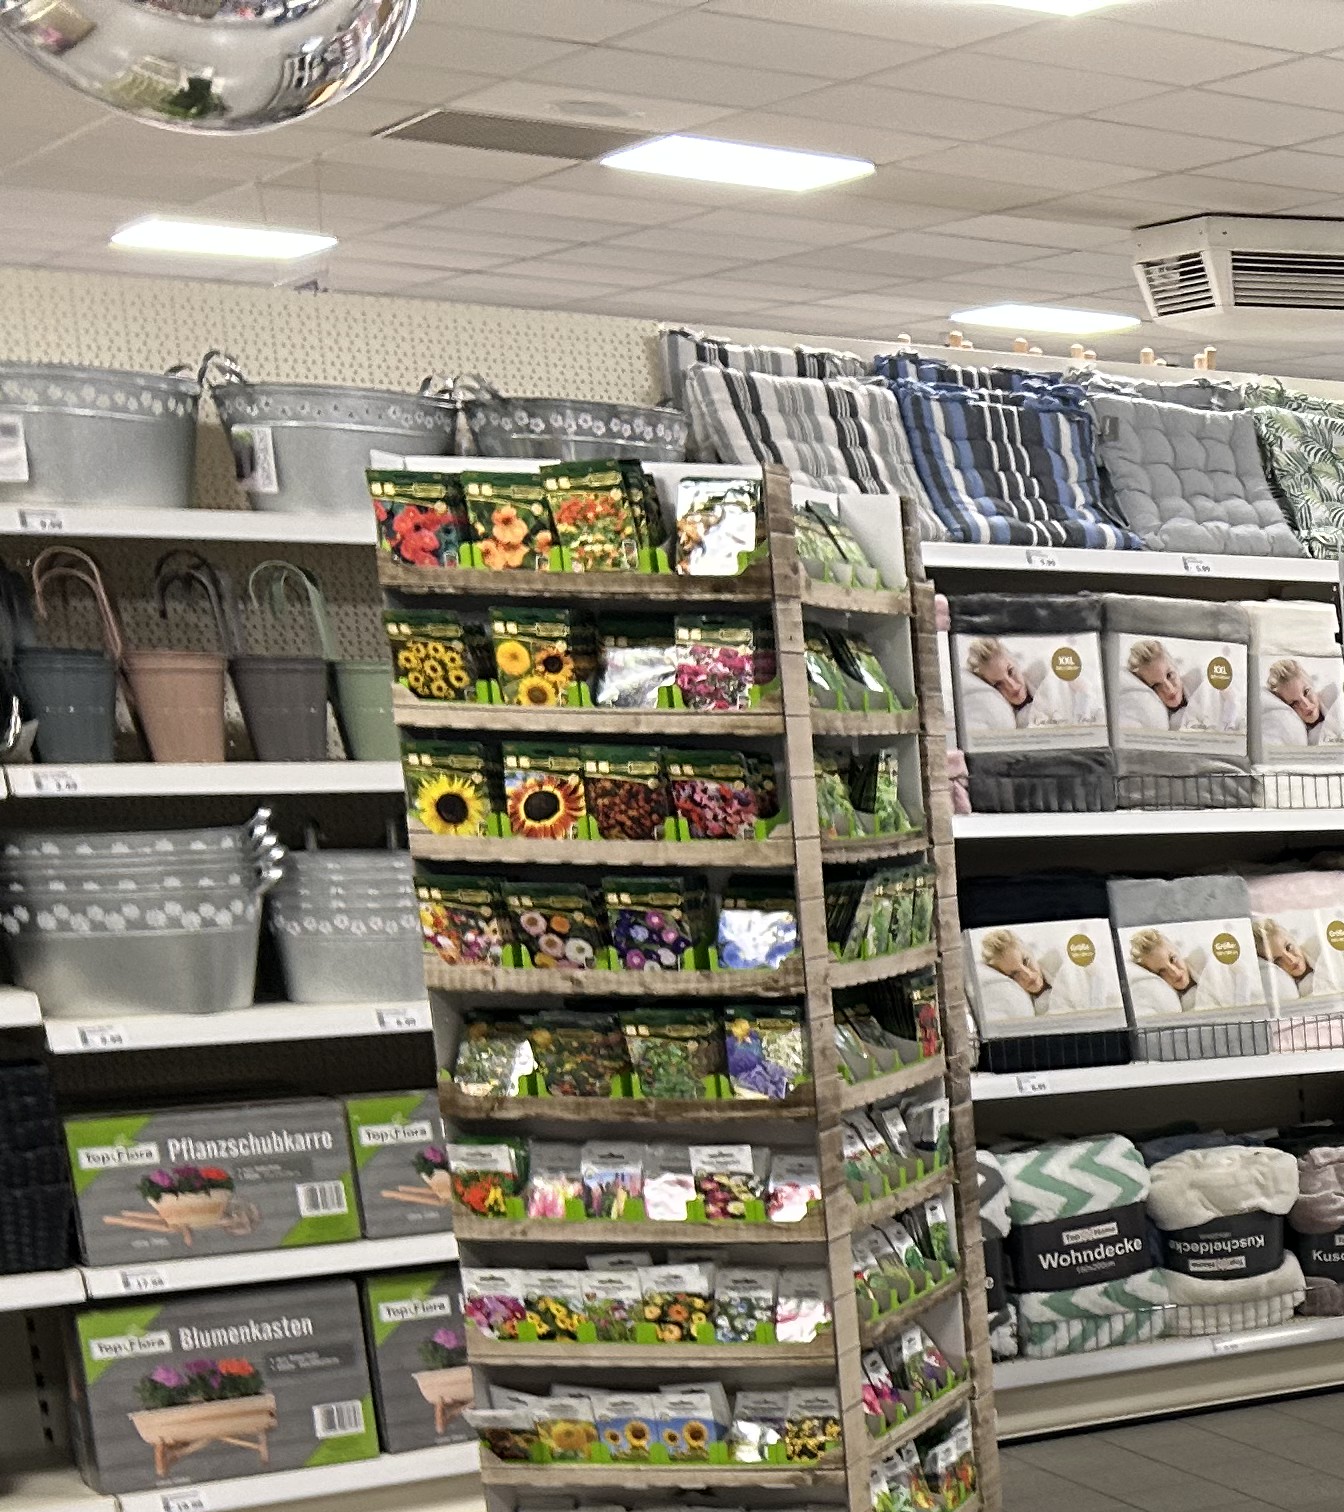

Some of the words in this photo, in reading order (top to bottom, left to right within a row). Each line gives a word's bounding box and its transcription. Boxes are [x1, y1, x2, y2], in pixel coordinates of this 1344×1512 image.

[365, 1128, 389, 1143] Top
[394, 1125, 429, 1139] Flora
[166, 1129, 334, 1163] Pflanzschubkarre
[84, 1152, 111, 1167] Top
[117, 1148, 154, 1162] Flora
[1038, 1236, 1143, 1271] Wohndecke
[1168, 1234, 1265, 1255] Kuscheldecke
[385, 1304, 410, 1318] Top
[413, 1300, 446, 1315] Flora
[178, 1314, 314, 1351] Blumenkasten
[97, 1341, 123, 1355] Top
[128, 1336, 166, 1352] Flora
